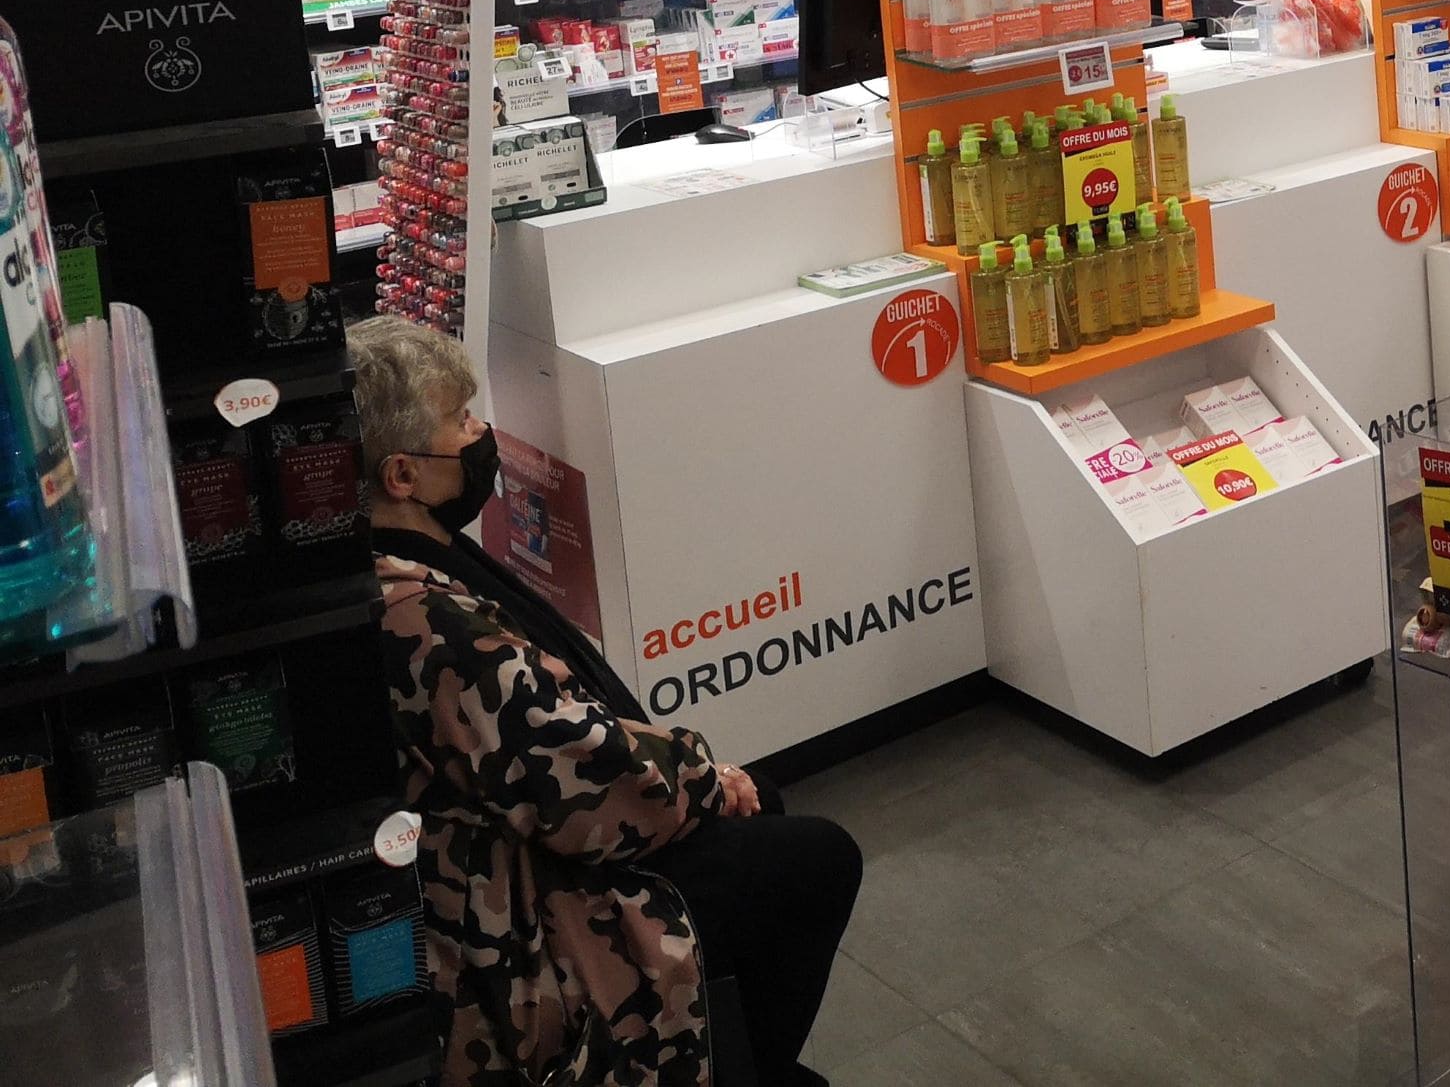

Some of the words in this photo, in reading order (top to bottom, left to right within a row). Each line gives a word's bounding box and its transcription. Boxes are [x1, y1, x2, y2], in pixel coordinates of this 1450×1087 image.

[97, 0, 236, 35] APIVITA
[536, 144, 578, 158] RICHELET
[1063, 133, 1091, 148] OFFRE
[1093, 130, 1105, 142] DU
[1107, 126, 1129, 139] MOIS
[1084, 180, 1117, 198] 9,95€
[1387, 167, 1426, 191] GUICHET
[1400, 197, 1419, 239] 2
[886, 294, 941, 323] GUICHET
[907, 330, 928, 378] 1
[223, 394, 273, 413] 3,90€
[1172, 444, 1201, 462] OFFRE
[1202, 439, 1215, 453] DU
[1216, 433, 1239, 449] MOIS
[1217, 477, 1254, 495] 10,90€
[642, 572, 803, 660] accueil
[649, 567, 974, 716] ORDONNANCE
[244, 865, 307, 888] APILLAIRES
[319, 854, 346, 868] HAIR
